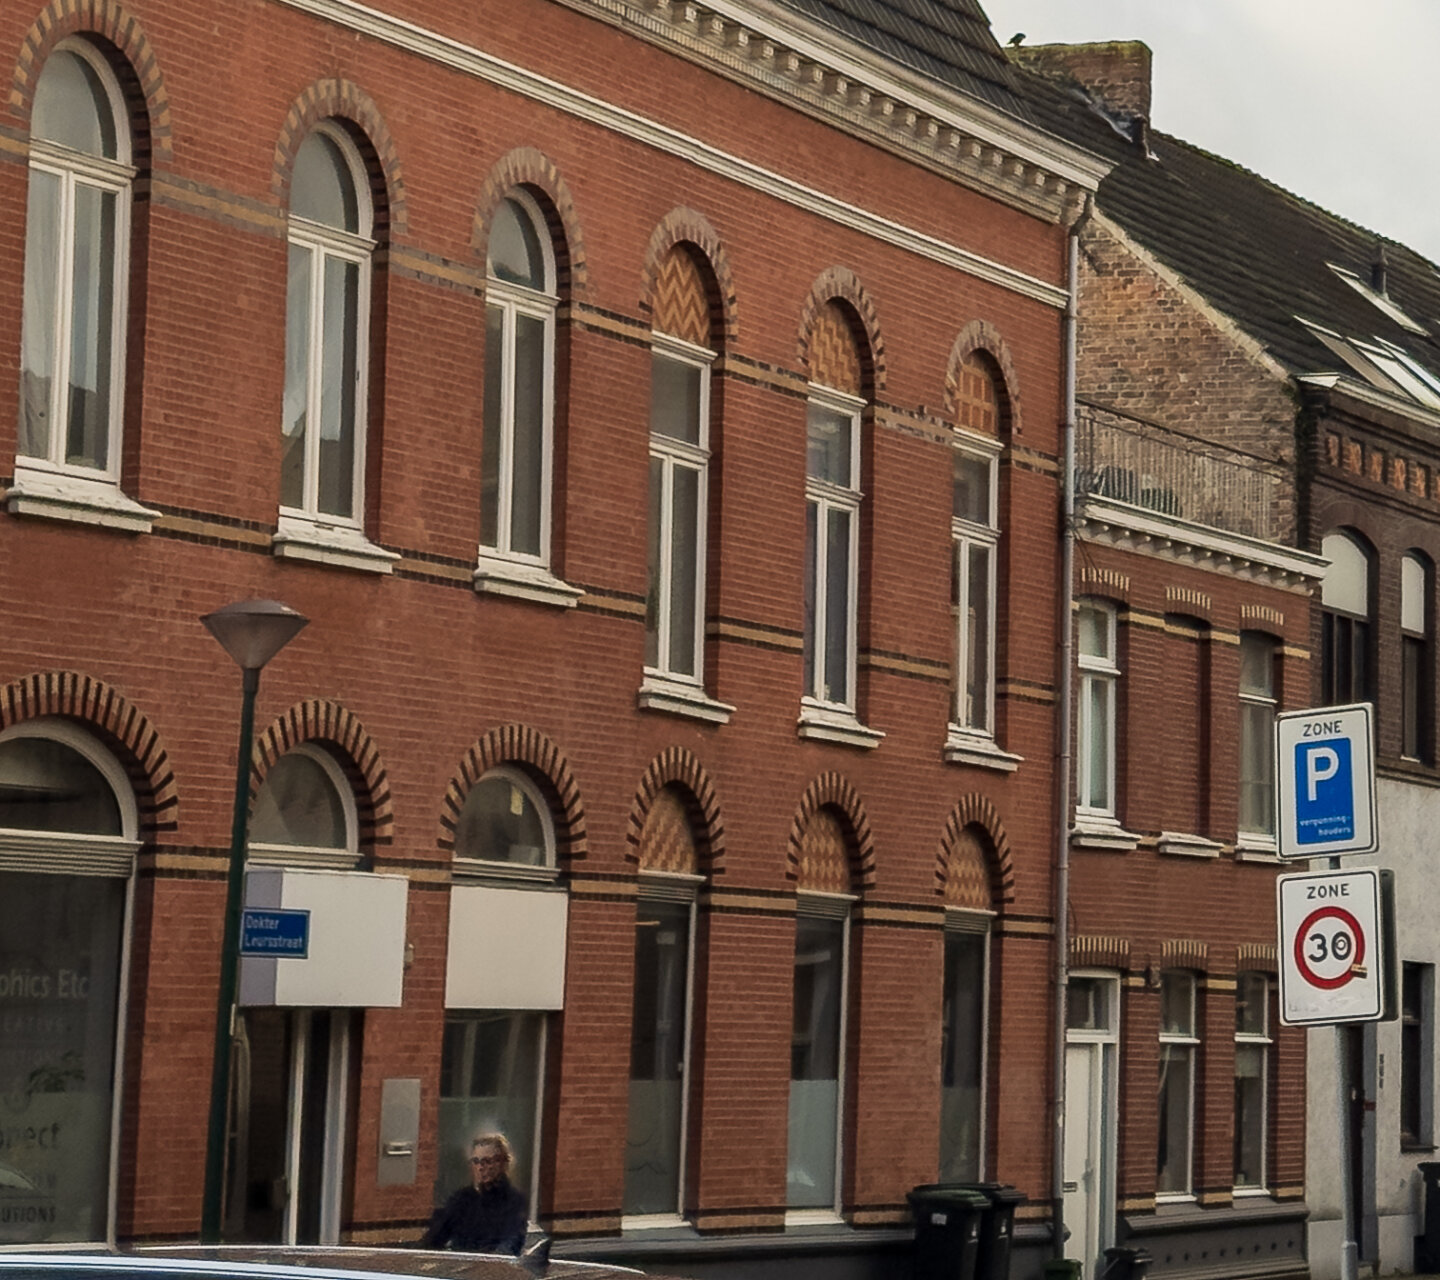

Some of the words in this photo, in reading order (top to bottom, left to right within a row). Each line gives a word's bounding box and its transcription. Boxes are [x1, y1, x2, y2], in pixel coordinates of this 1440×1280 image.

[1303, 719, 1342, 737] ZONE
[1307, 746, 1340, 801] P
[1317, 825, 1352, 836] houders
[1306, 883, 1350, 899] ZONE
[245, 915, 279, 929] Dokter
[1308, 931, 1352, 963] 30
